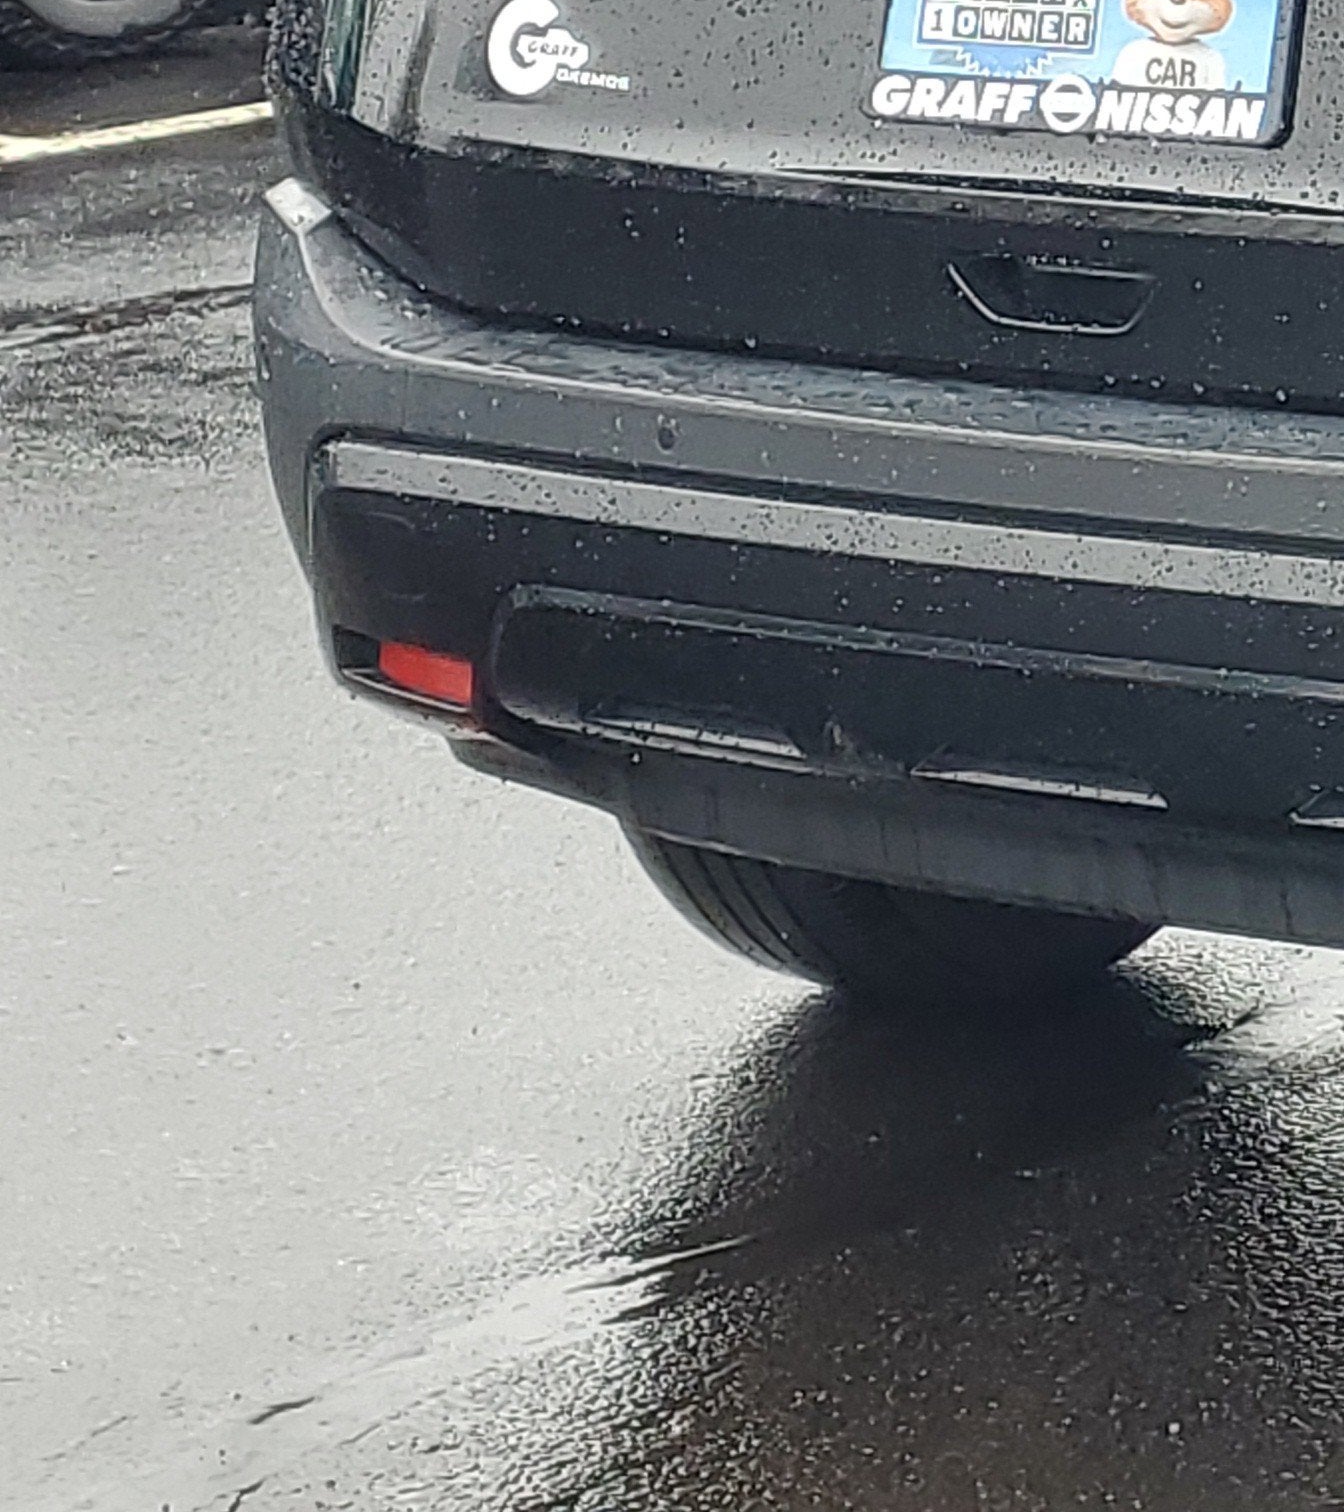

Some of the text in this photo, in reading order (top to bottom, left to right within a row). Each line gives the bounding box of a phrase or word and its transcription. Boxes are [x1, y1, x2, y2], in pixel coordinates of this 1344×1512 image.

[929, 8, 1092, 46] 1 OWNER
[1145, 56, 1197, 88] CAR
[870, 74, 1266, 140] GRAFF NISSAN
